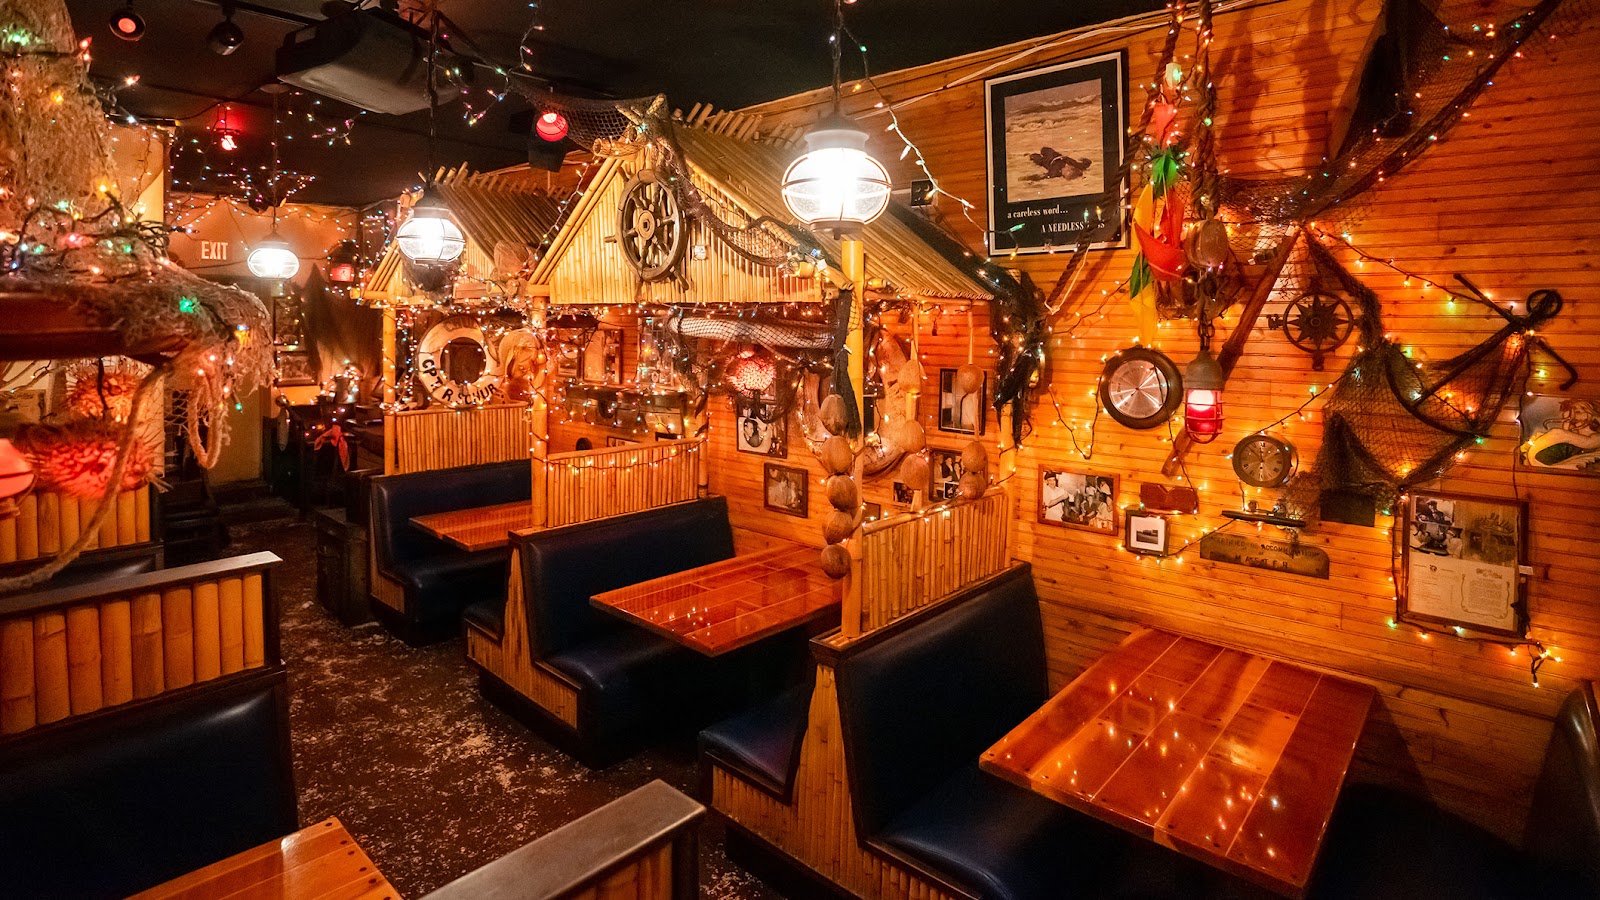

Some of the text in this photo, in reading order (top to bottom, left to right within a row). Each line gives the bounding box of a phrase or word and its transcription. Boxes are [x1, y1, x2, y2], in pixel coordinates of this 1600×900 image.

[1013, 207, 1041, 219] careless
[1048, 221, 1085, 233] NEEDLESS
[201, 241, 229, 260] EXIT
